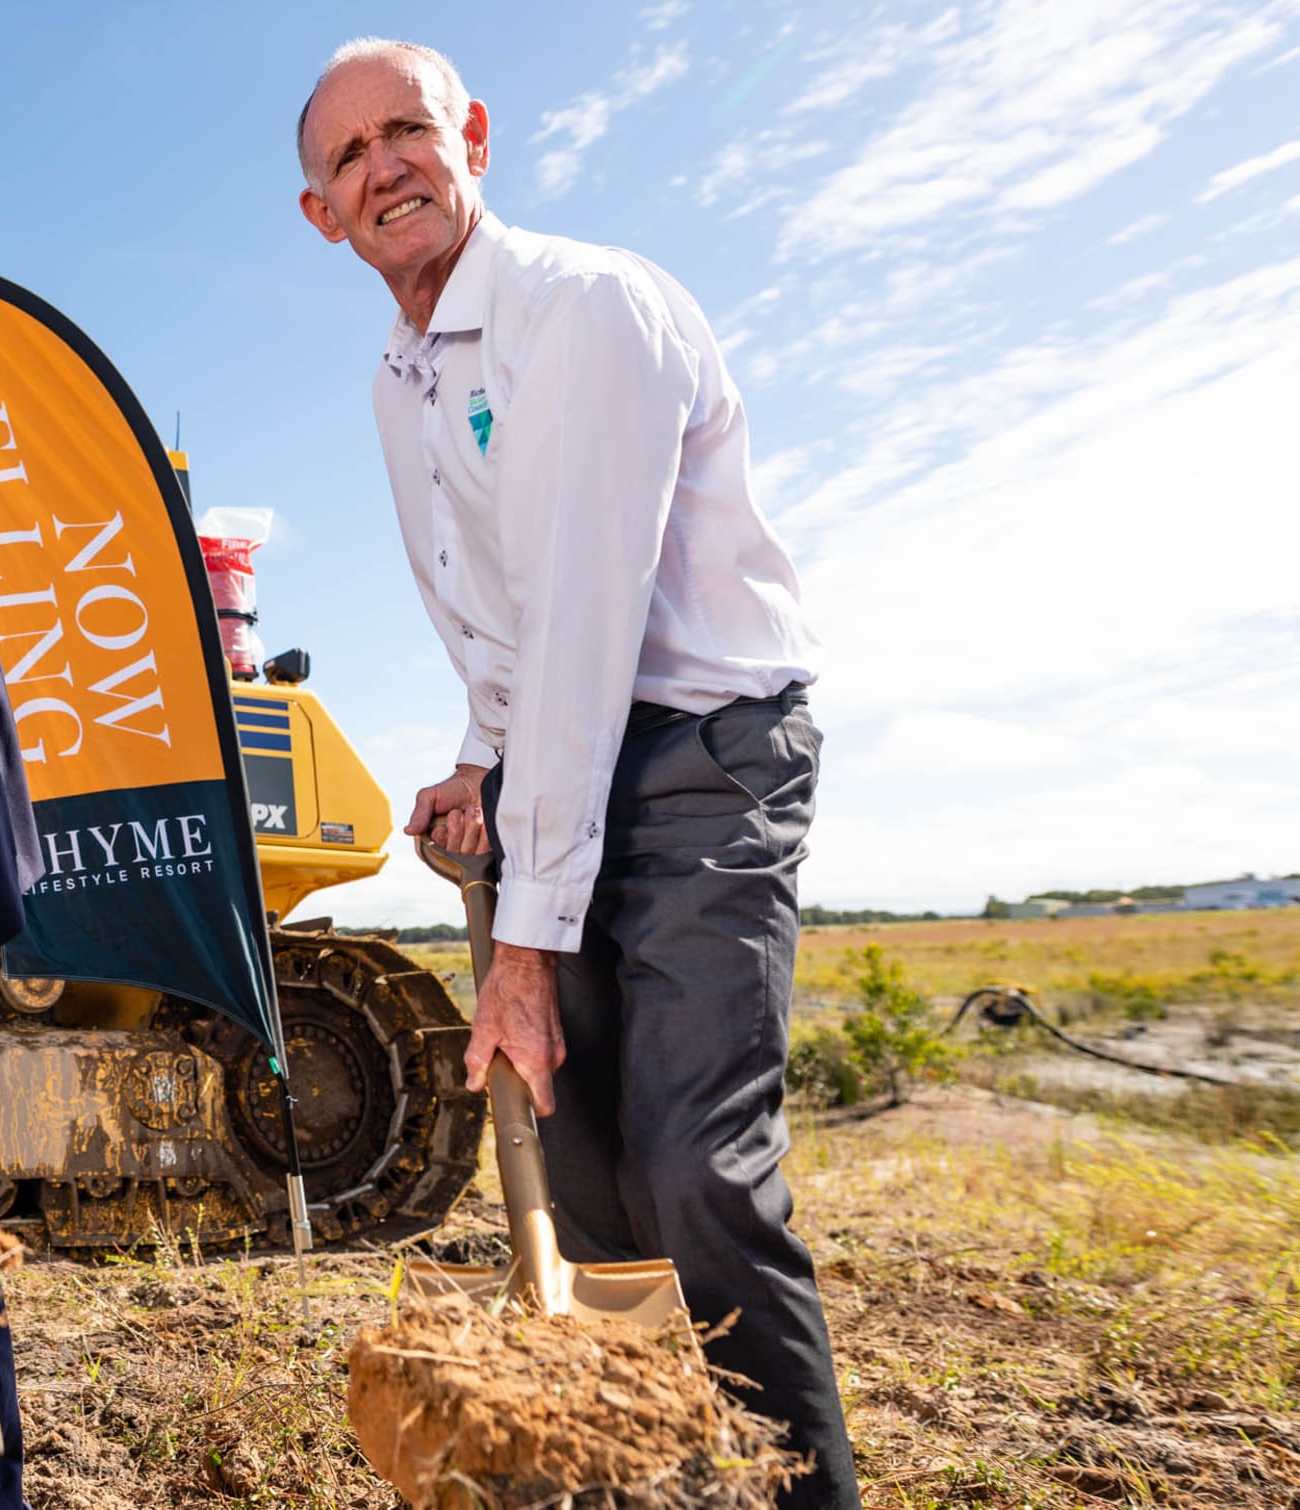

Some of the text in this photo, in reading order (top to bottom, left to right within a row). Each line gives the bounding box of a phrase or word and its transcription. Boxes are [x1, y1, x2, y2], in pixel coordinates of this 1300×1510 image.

[52, 510, 172, 749] NOW
[43, 814, 212, 875] HYME
[22, 860, 214, 896] IFESTYLE RESORT
